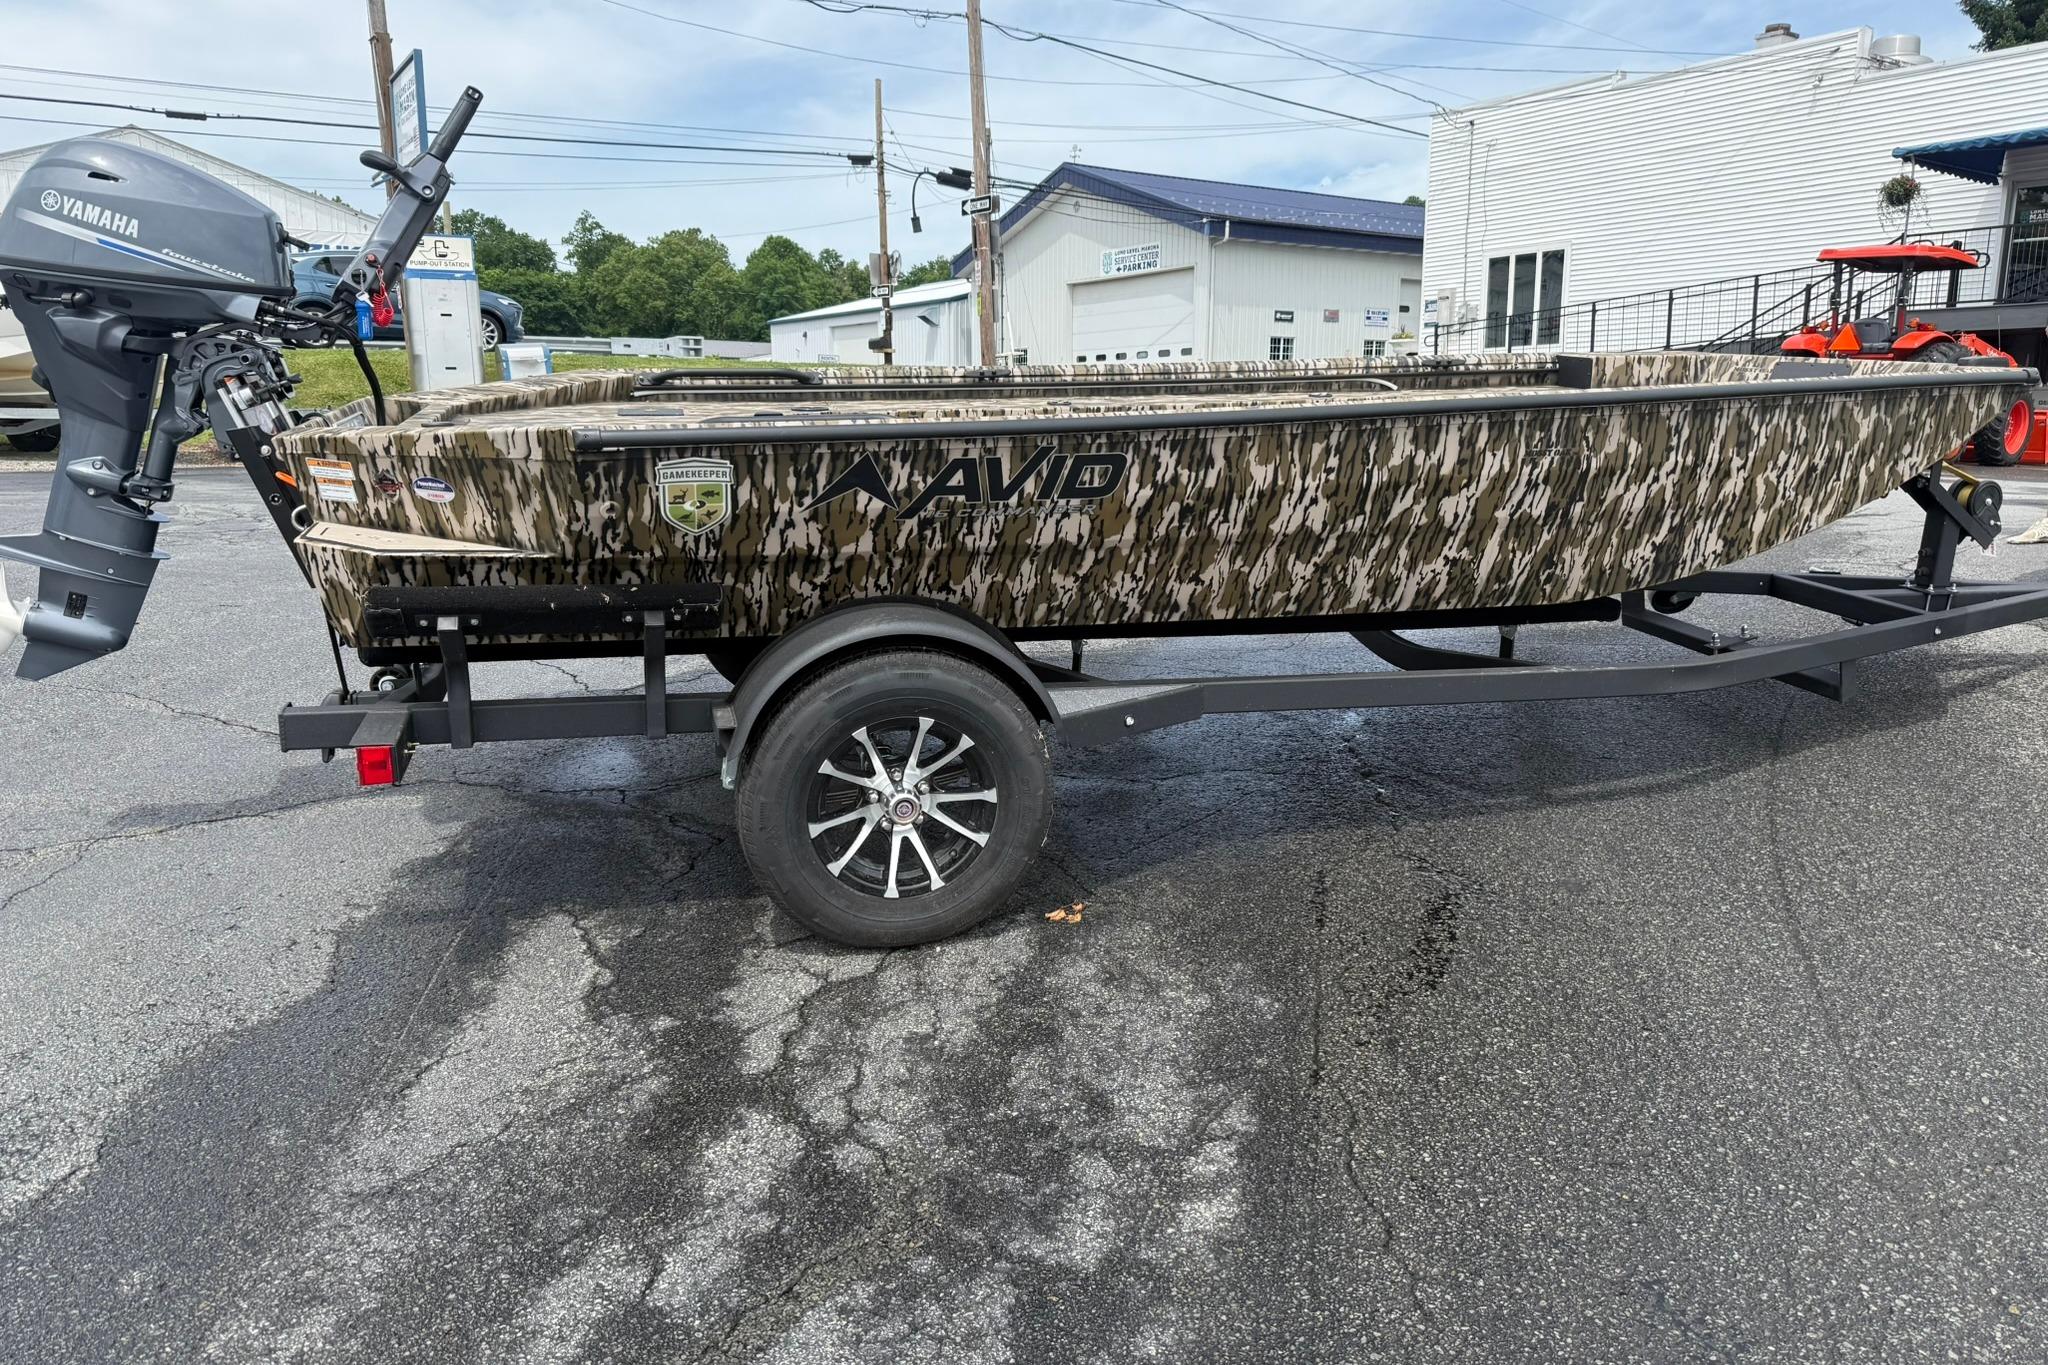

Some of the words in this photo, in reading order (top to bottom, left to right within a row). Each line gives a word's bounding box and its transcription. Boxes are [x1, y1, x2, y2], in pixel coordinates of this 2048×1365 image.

[62, 195, 139, 238] YAMAHA
[1114, 254, 1136, 265] SERVICE
[1138, 251, 1159, 261] CENTER
[1122, 260, 1158, 272] PARKING
[662, 469, 728, 480] GAMEKEEPER
[895, 445, 1128, 519] AVID
[956, 504, 1096, 518] COMMANDER
